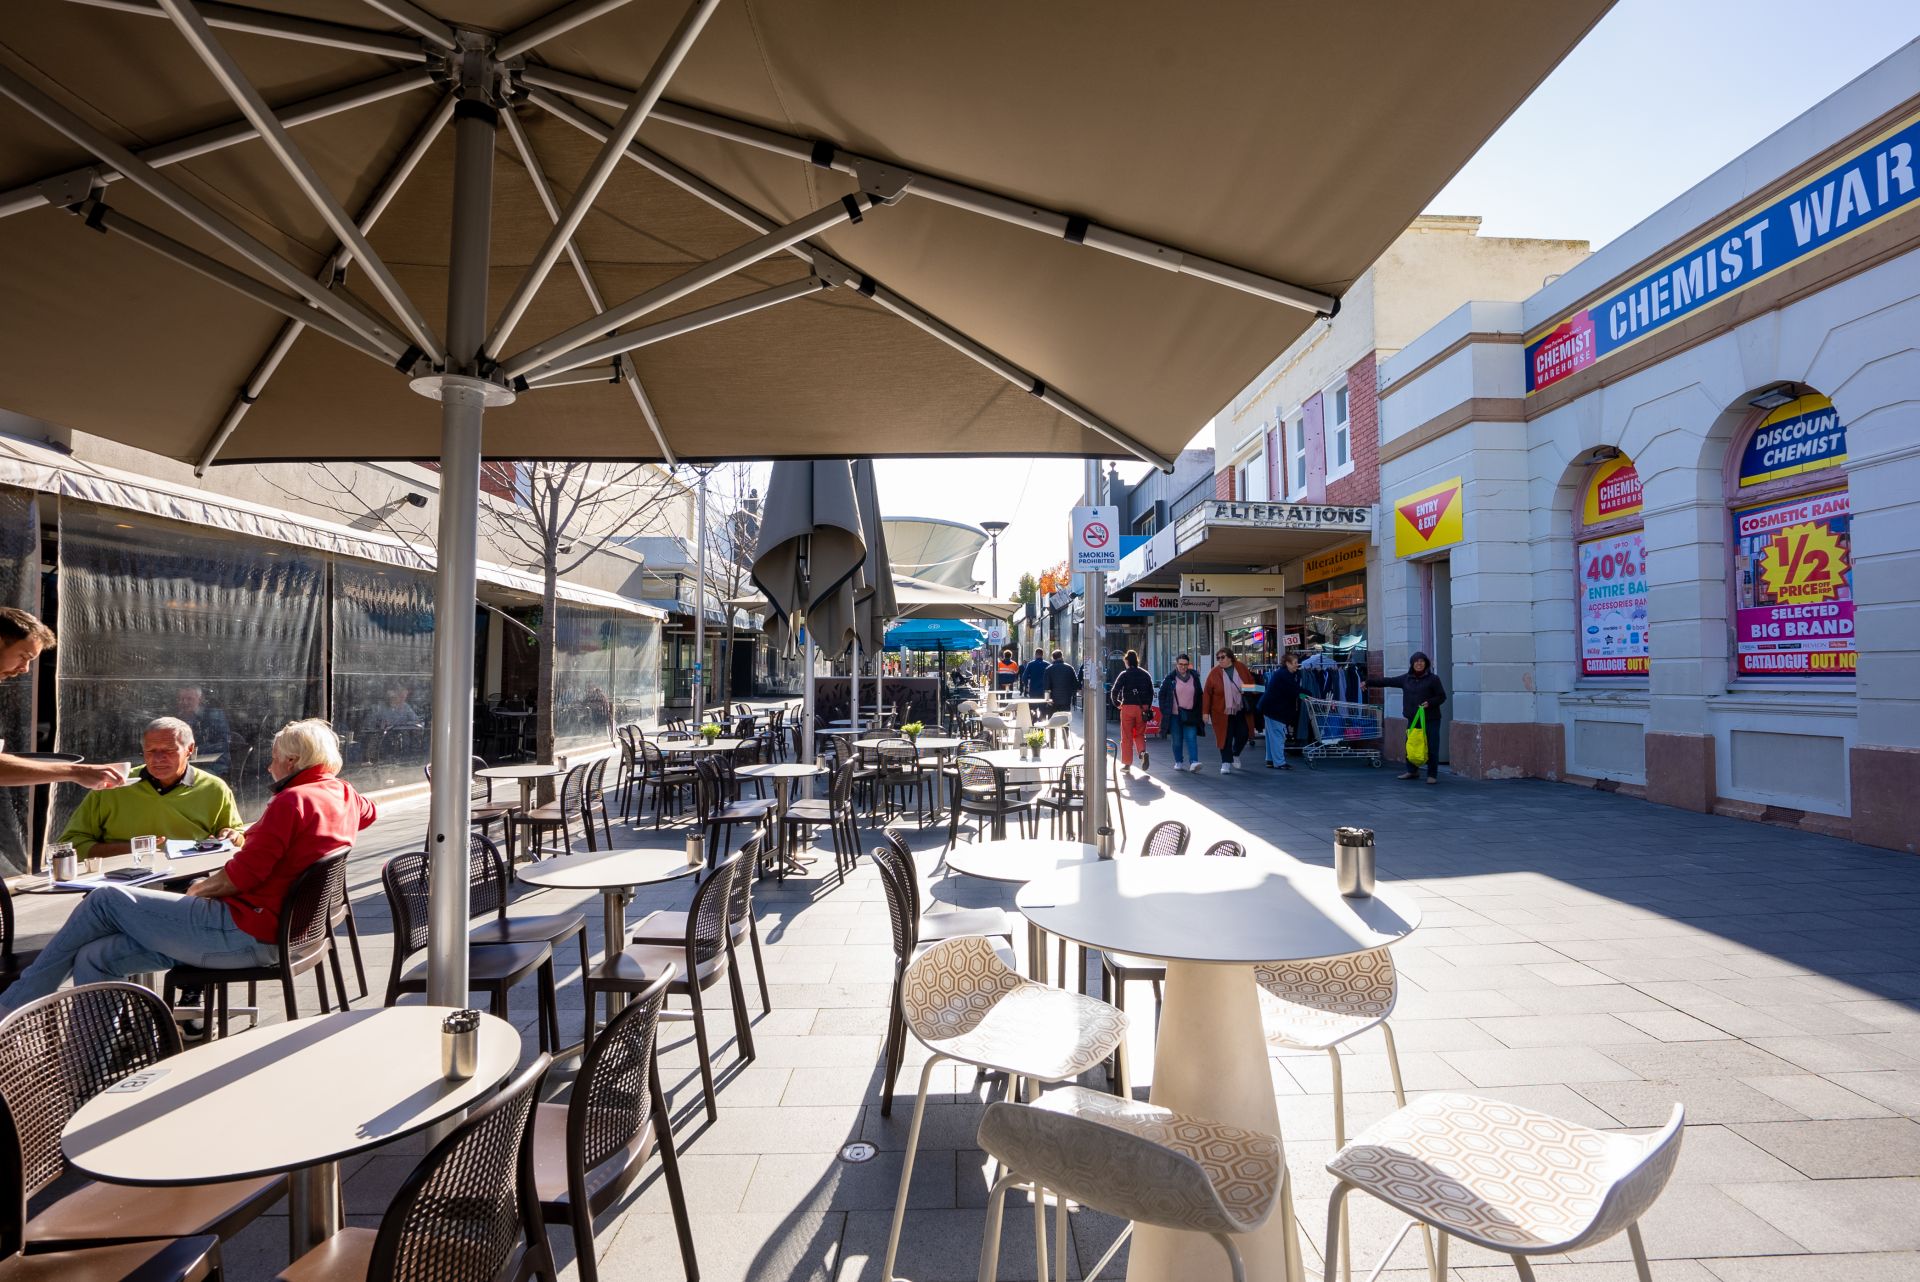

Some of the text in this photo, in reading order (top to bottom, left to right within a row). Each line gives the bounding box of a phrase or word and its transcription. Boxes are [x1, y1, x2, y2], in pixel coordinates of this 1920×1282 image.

[1609, 142, 1915, 341] CHEMIST WAR
[1536, 329, 1592, 373] CHEMIST
[1537, 350, 1591, 384] WAREHOUSE
[1763, 432, 1841, 467] CHEMIST
[1416, 499, 1439, 517] ENTRY
[1601, 493, 1642, 510] WAREHOUS
[1418, 514, 1437, 531] & EXIT
[1742, 506, 1808, 532] COSMETIC
[1078, 551, 1115, 559] SMOKING
[1305, 547, 1364, 574] Alterations
[1775, 533, 1831, 585] 1/2
[1587, 550, 1636, 582] 40%
[1589, 584, 1625, 600] ENTIRE
[1779, 582, 1819, 597] PRICE
[1589, 600, 1633, 611] ACCESSORIES
[1771, 604, 1839, 620] SELECTED
[1751, 618, 1853, 638] BIG BRAND
[1586, 658, 1626, 672] CATALOGUE
[1627, 658, 1643, 671] OUT
[1744, 652, 1808, 669] CATALOGUE
[1810, 652, 1837, 669] OUT
